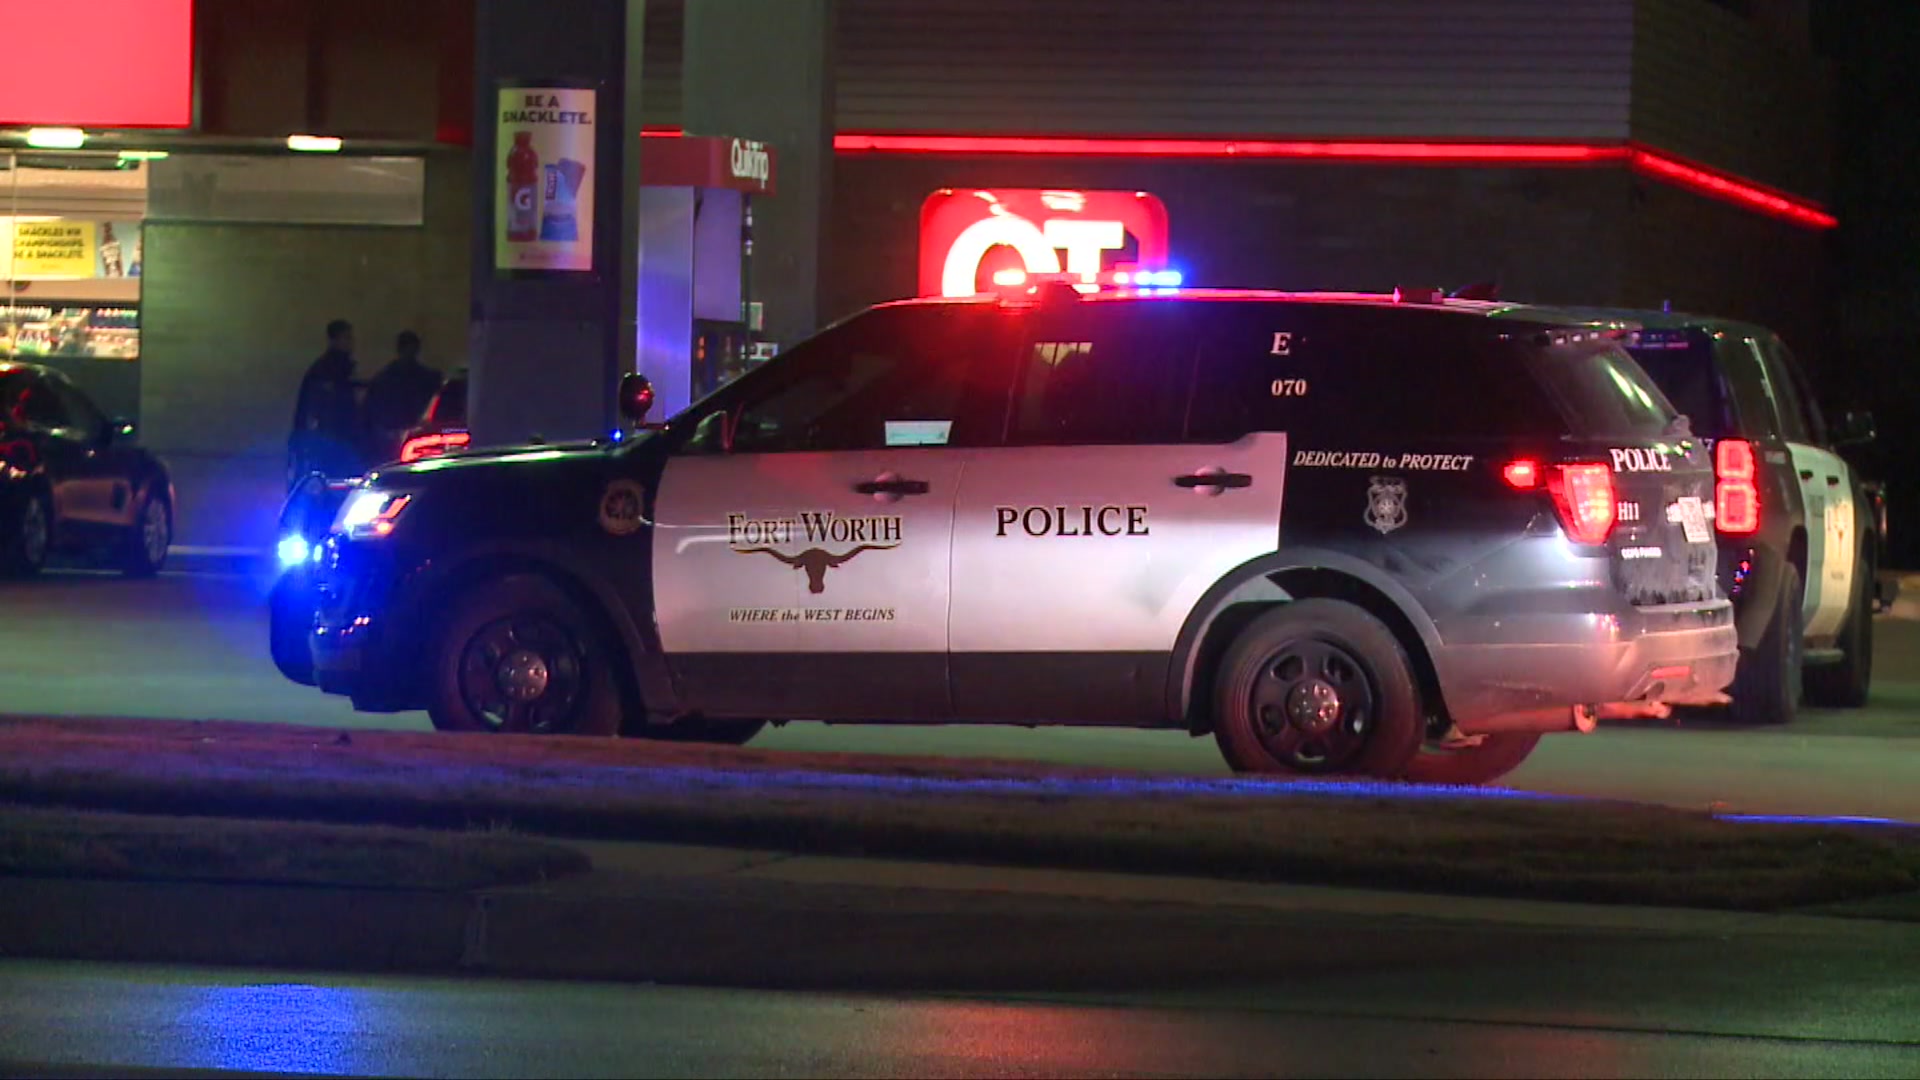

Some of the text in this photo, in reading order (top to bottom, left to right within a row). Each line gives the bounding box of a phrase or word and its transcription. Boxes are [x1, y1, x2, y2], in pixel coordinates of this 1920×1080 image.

[524, 94, 561, 108] BE A
[502, 109, 592, 125] SNACKLETE.
[732, 138, 769, 189] QuikTrip
[515, 188, 531, 210] G
[1270, 332, 1291, 356] E
[1271, 379, 1307, 397] 070
[1293, 450, 1473, 471] DEDICATED to PROTECT
[1609, 448, 1672, 473] POLICE
[995, 505, 1150, 537] POLICE
[1617, 502, 1640, 521] H11
[729, 511, 902, 544] FORT WORTH
[729, 608, 895, 622] WHERE the WEST BEGINS
